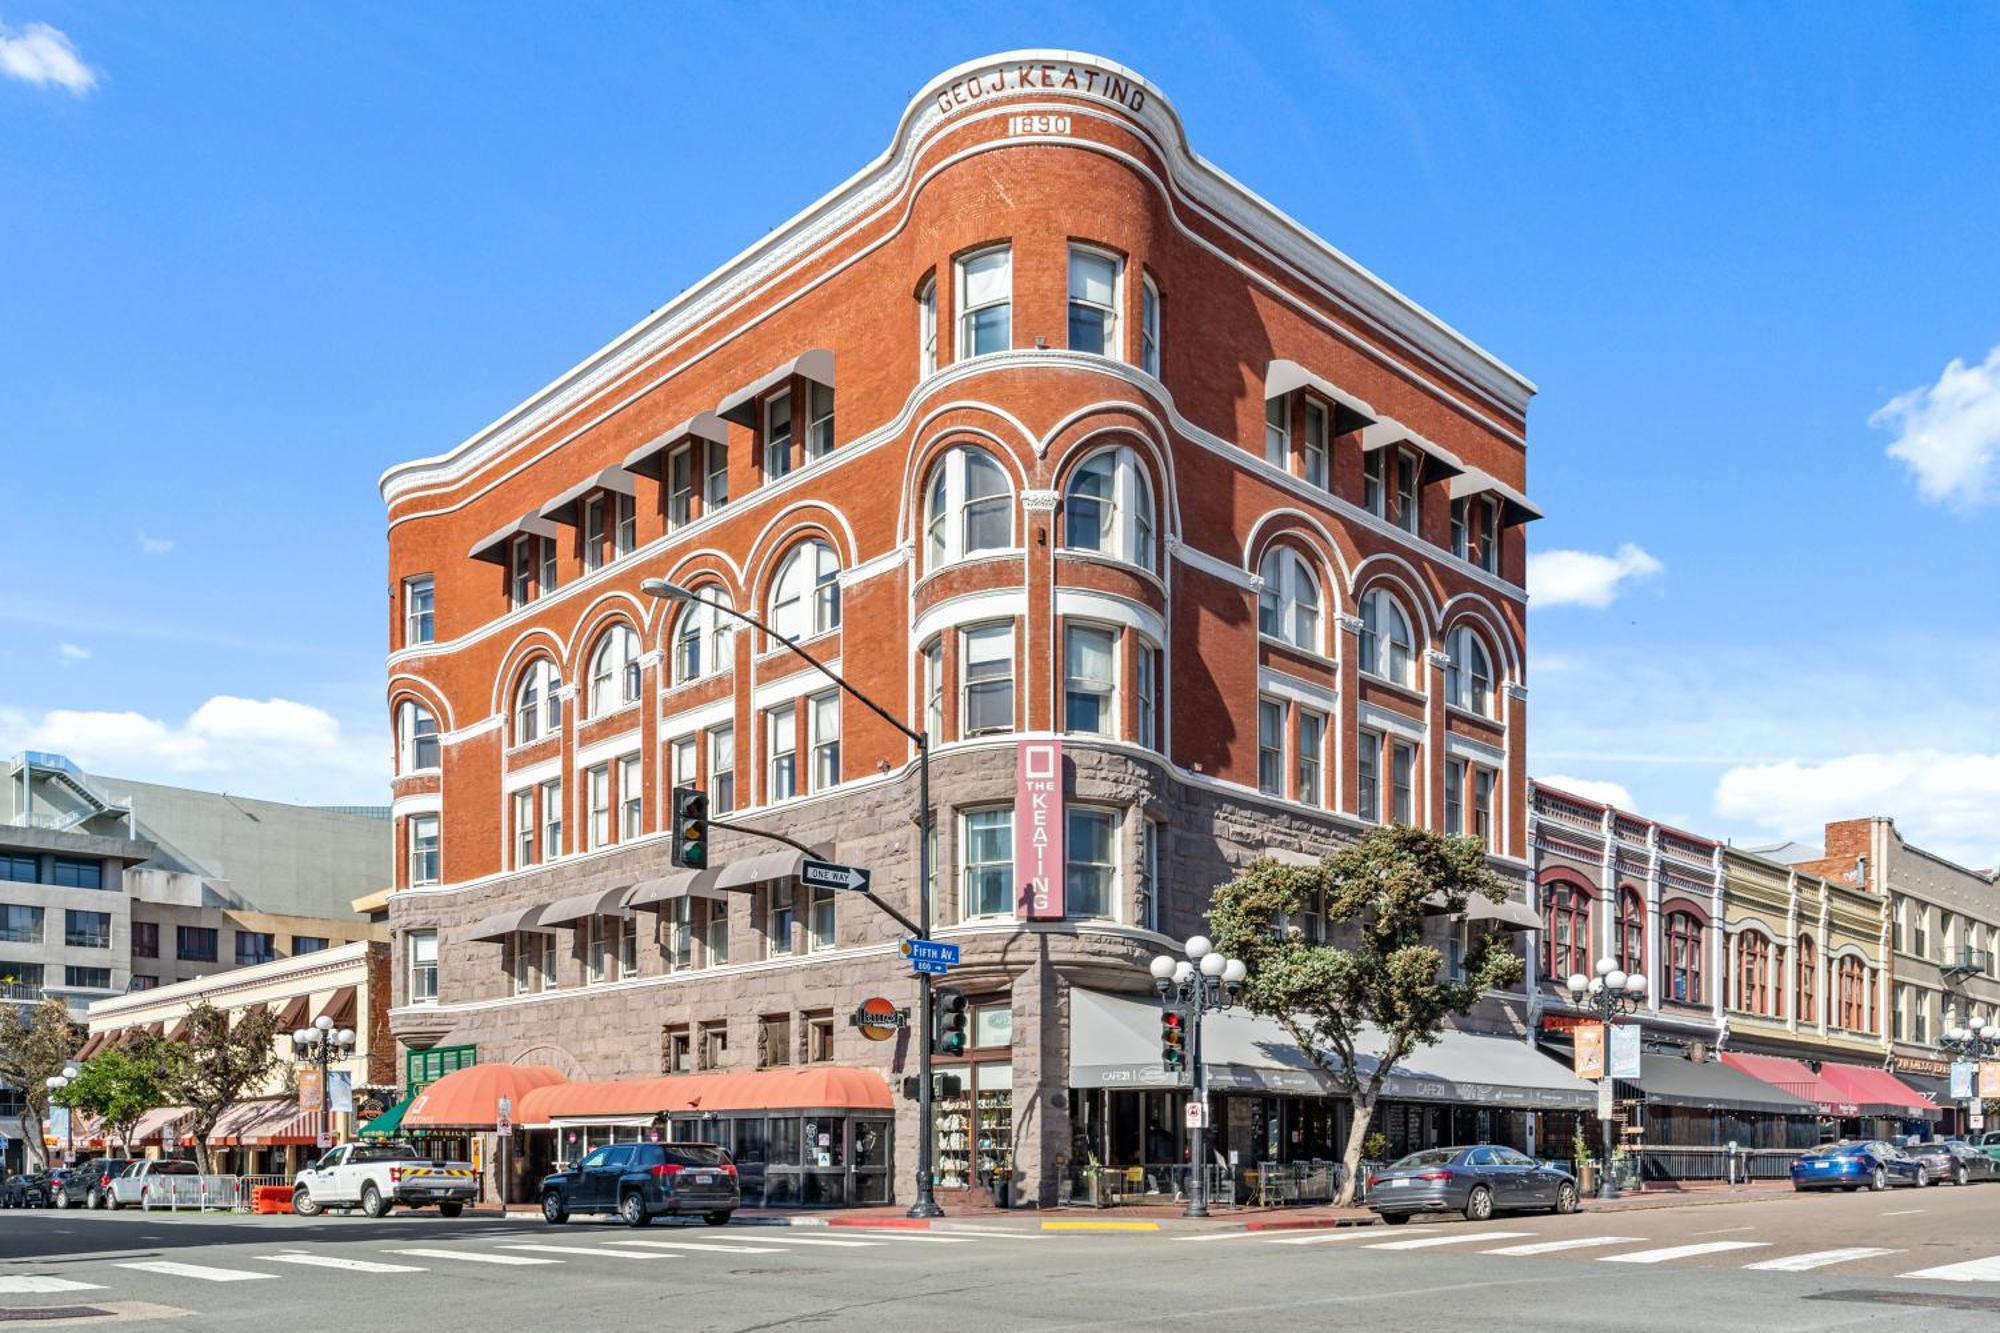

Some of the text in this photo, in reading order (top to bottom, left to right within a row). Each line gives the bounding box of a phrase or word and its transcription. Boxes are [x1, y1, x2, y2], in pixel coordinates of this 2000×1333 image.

[1018, 64, 1146, 113] KEATING
[1012, 117, 1068, 134] 1890
[1025, 781, 1055, 791] THE
[1032, 793, 1049, 910] KEATING
[812, 869, 849, 882] ONE WAY
[913, 944, 938, 959] FIFTH
